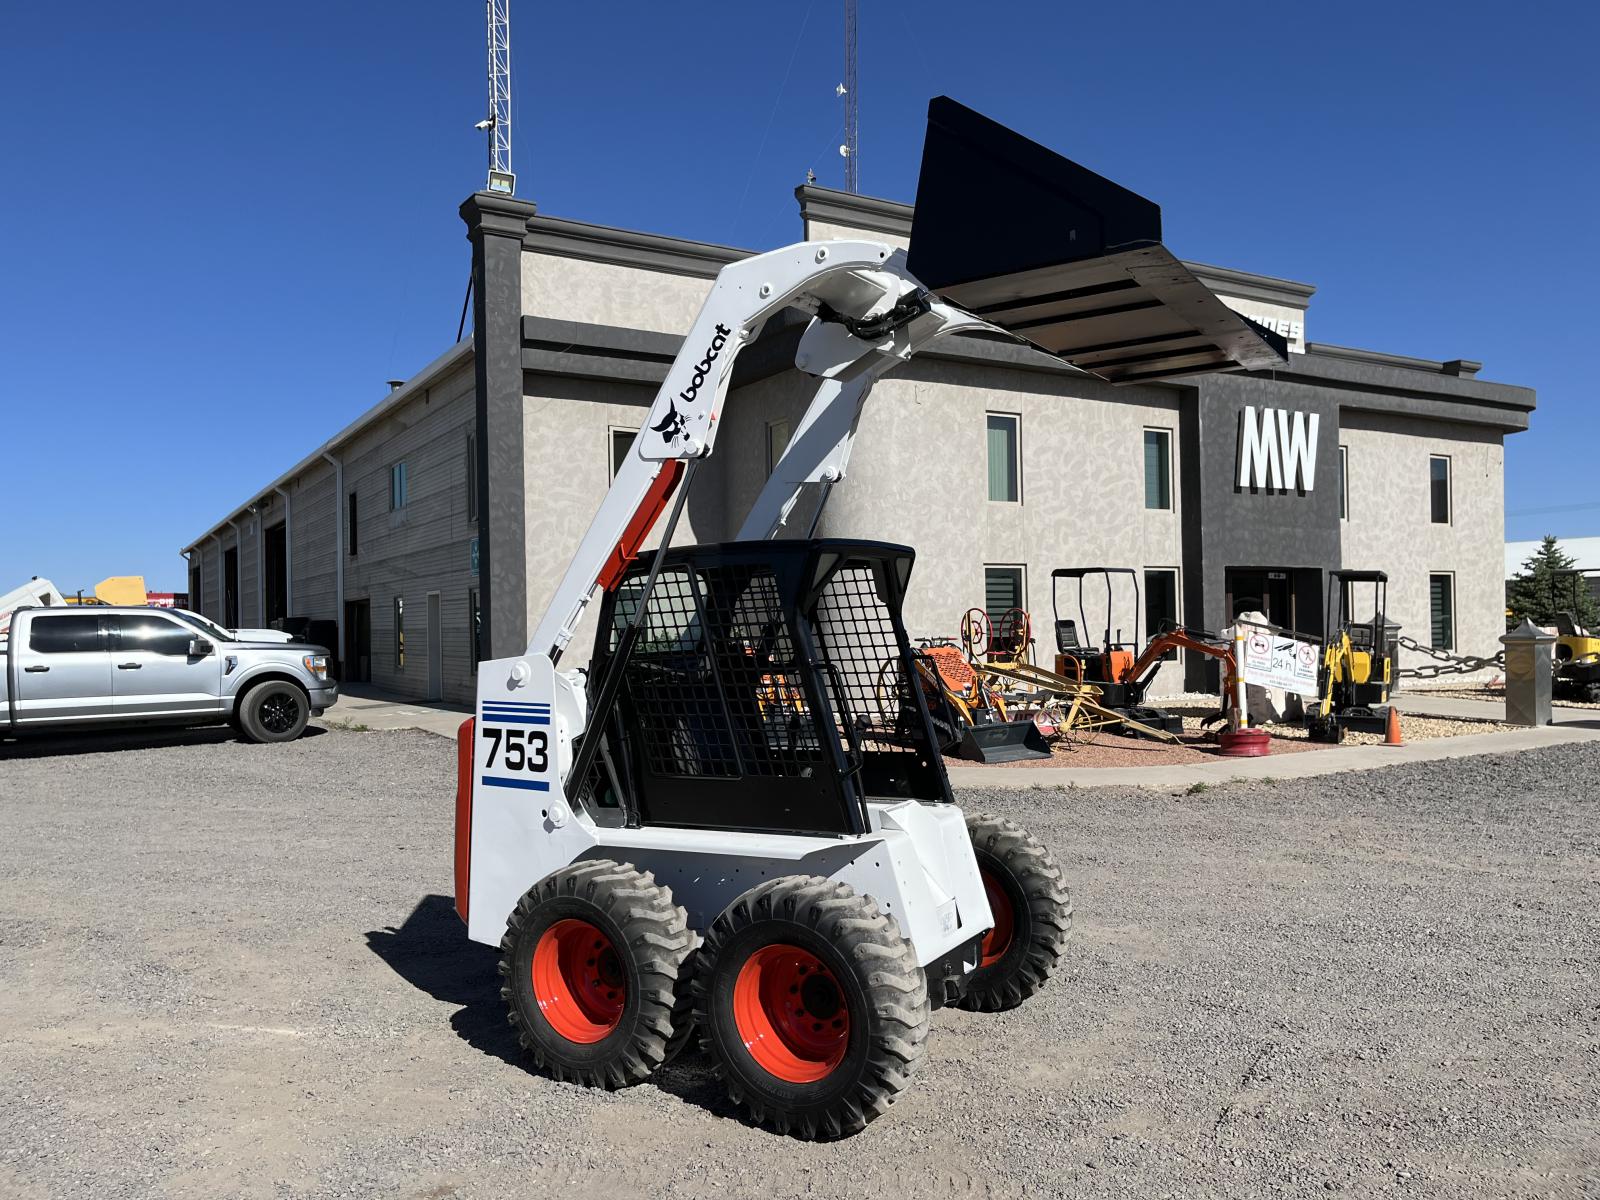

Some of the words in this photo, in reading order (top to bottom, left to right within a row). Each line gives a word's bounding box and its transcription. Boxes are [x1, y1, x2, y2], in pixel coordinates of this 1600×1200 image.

[680, 323, 732, 403] bobcat
[1240, 406, 1319, 491] MW
[1272, 657, 1283, 669] 24
[482, 727, 549, 773] 753
